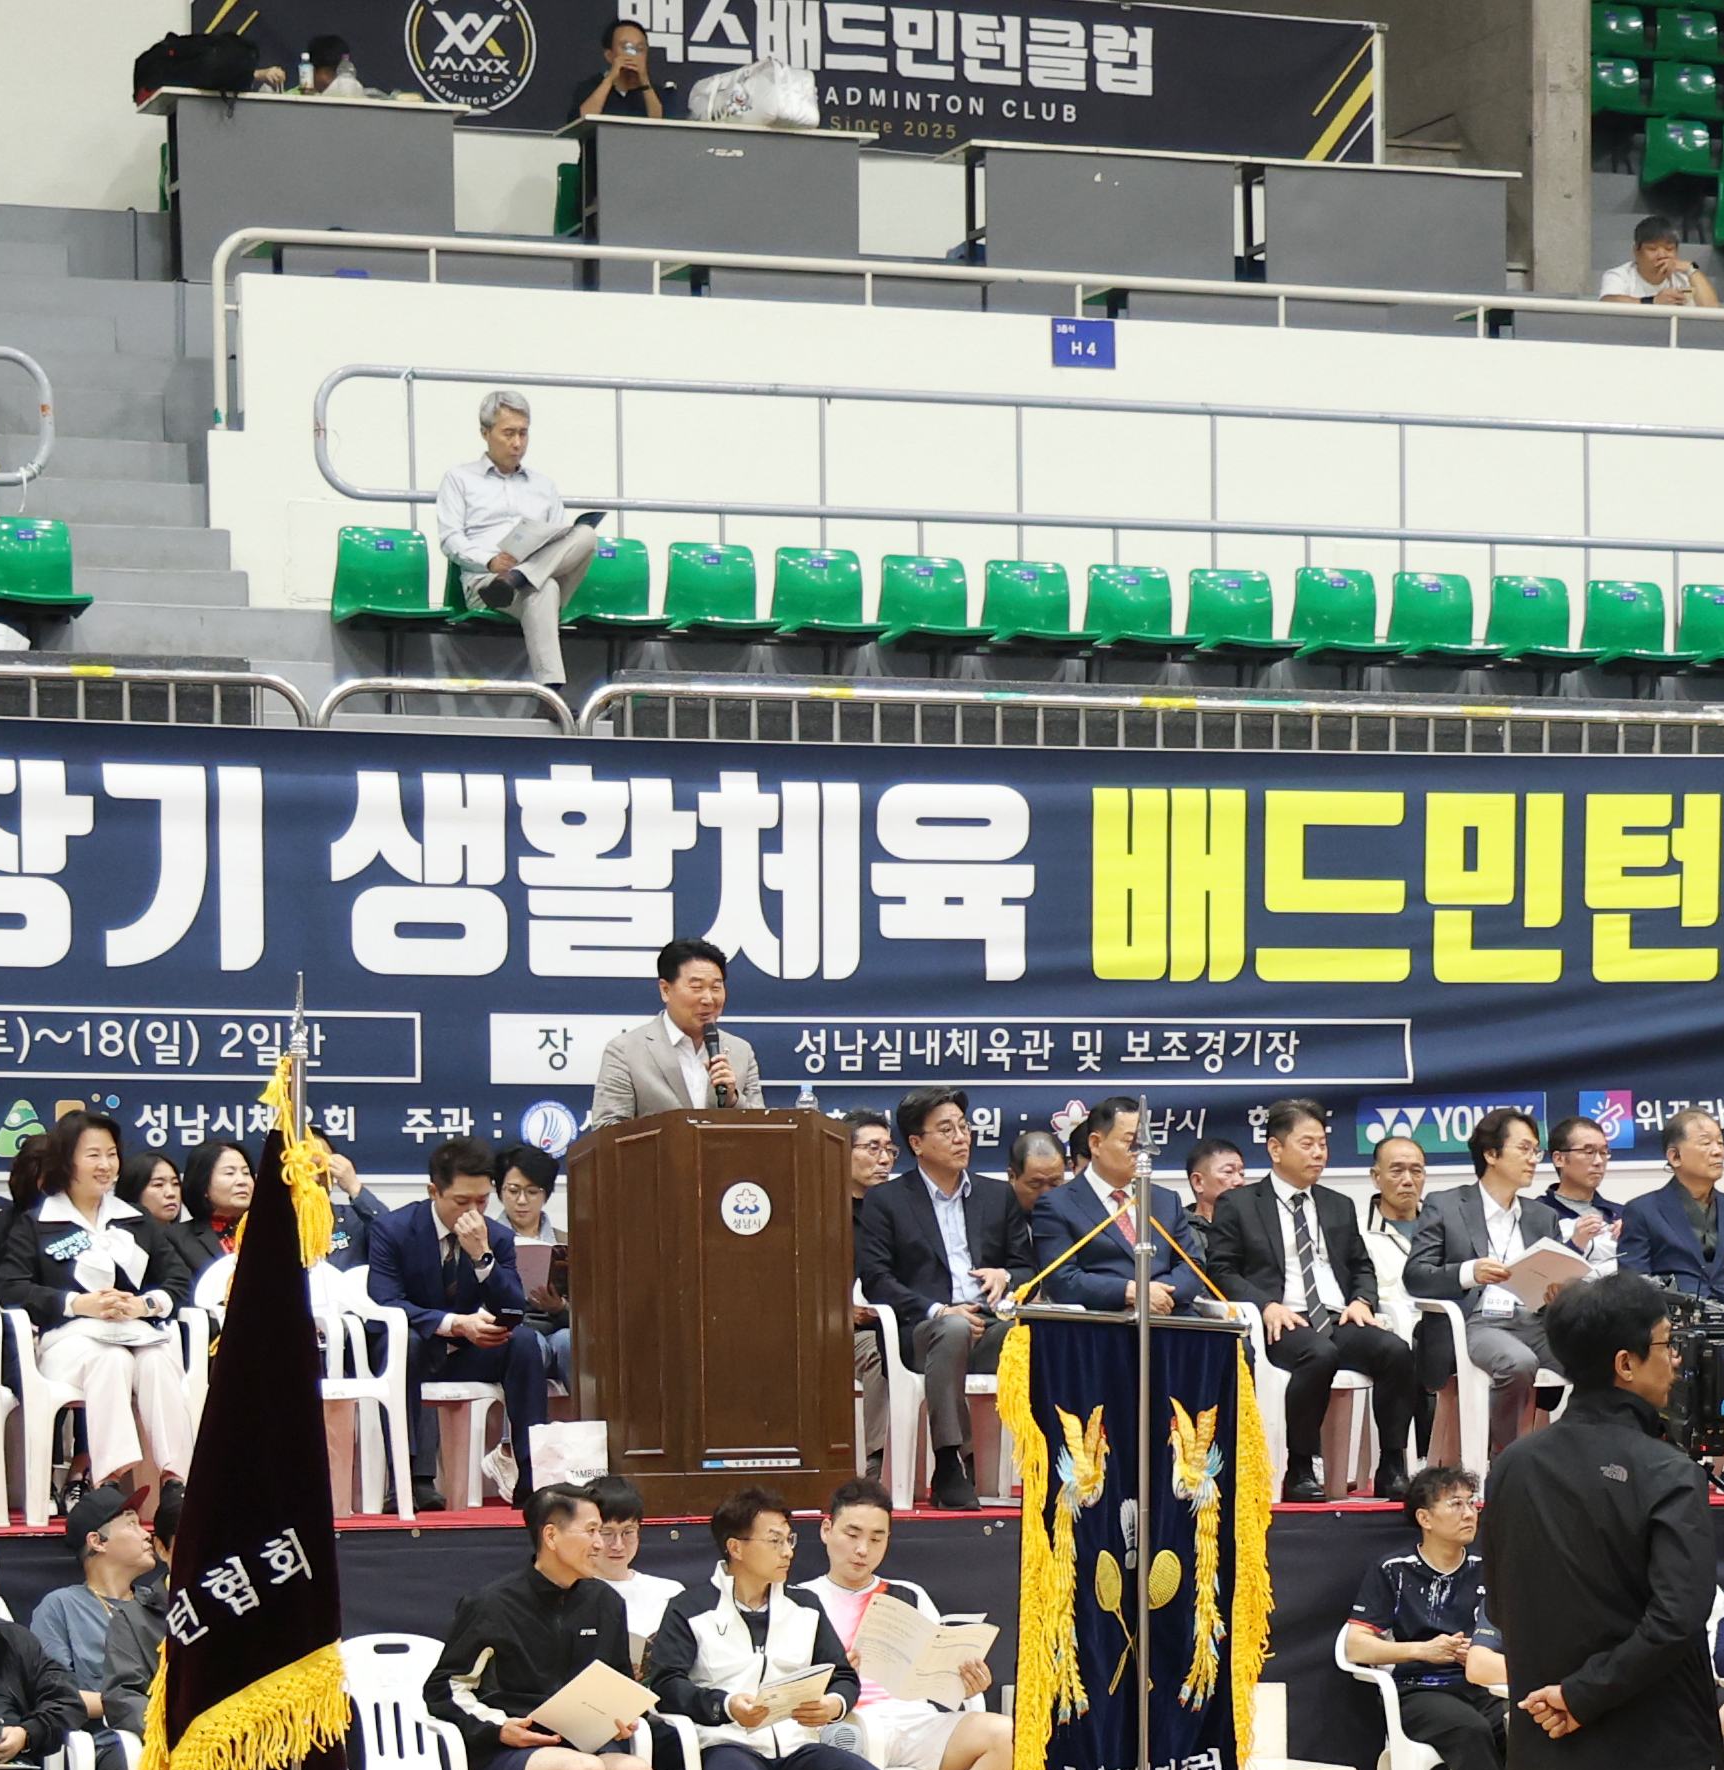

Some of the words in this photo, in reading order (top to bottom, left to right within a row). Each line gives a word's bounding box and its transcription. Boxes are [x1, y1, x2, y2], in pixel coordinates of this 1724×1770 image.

[429, 56, 511, 74] MAXX
[427, 73, 489, 105] BADMINTON
[492, 78, 518, 102] CLUB
[823, 86, 985, 117] ADMINTON
[1002, 99, 1078, 123] CLUB
[904, 119, 957, 140] 2025
[1070, 341, 1083, 356] H
[1086, 341, 1097, 357] 4
[328, 763, 1037, 984] 생활체육
[794, 1026, 1055, 1075] 성남실내체육관
[1072, 1027, 1103, 1074] 및
[1120, 1027, 1301, 1074] 보조경기장
[134, 1103, 357, 1146] 성남시체회
[402, 1107, 475, 1145] 주관
[1145, 1108, 1207, 1145] 남시
